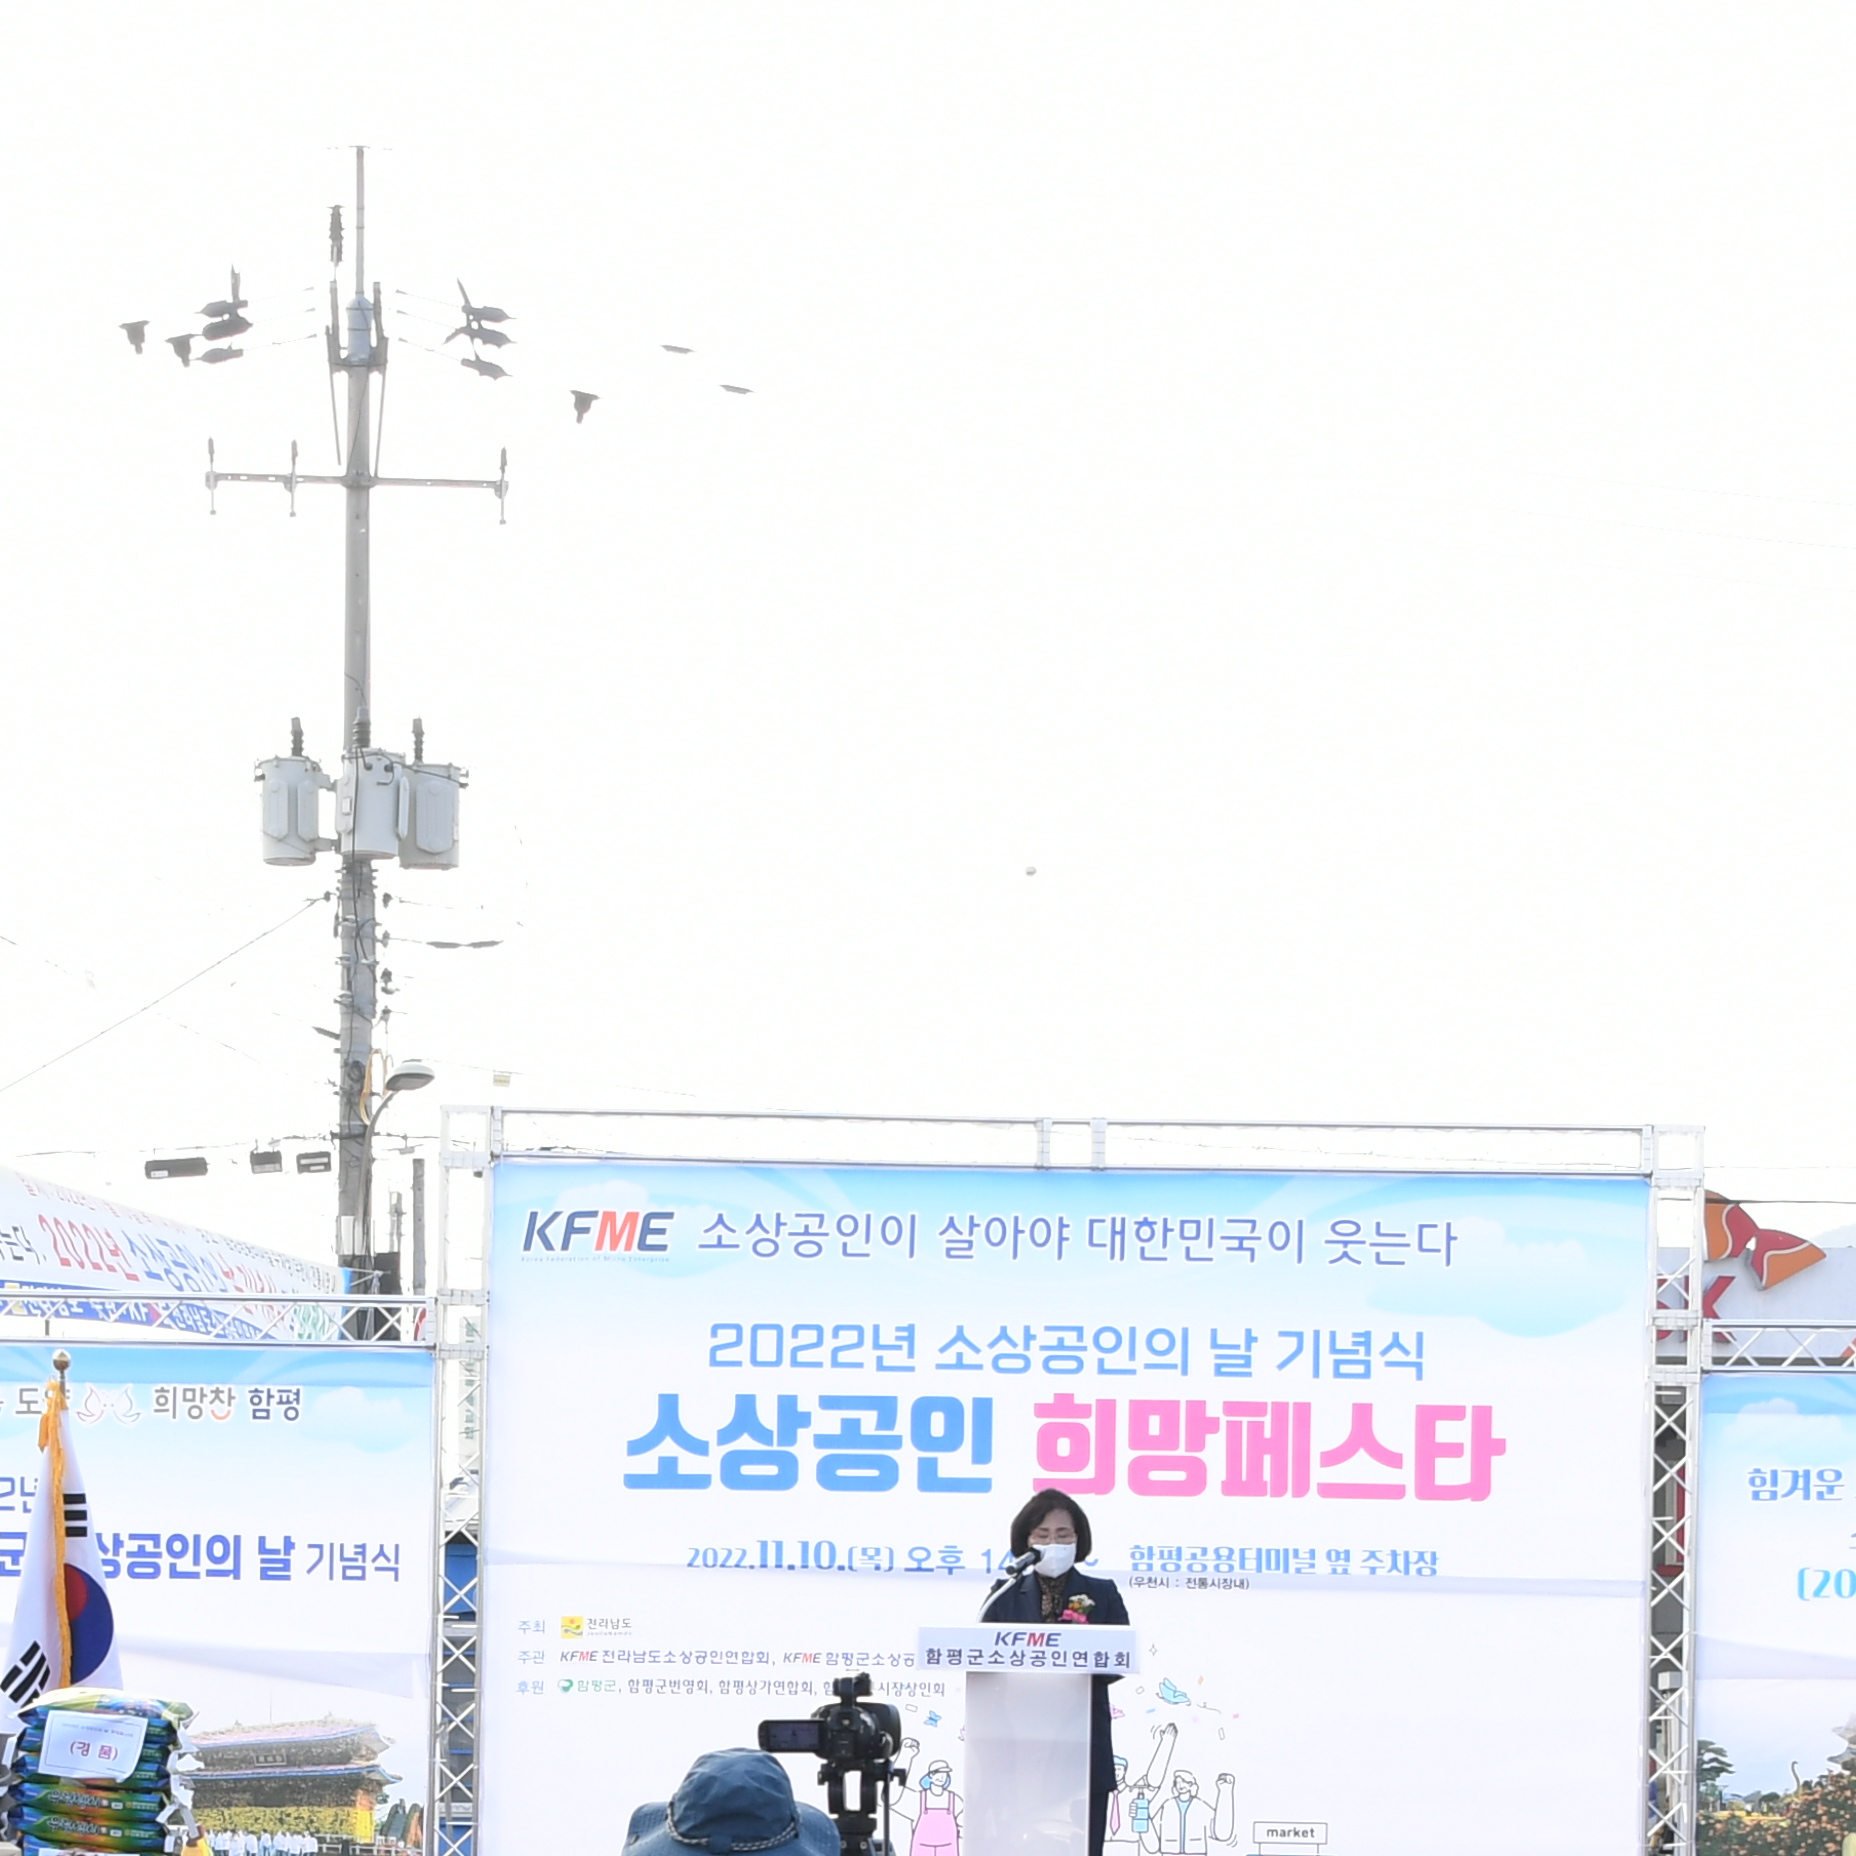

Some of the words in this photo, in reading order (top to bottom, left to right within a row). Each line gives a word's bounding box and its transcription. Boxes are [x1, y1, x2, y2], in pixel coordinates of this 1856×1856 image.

[523, 1210, 675, 1252] KFME
[698, 1212, 917, 1260] 소상공인이
[938, 1213, 1071, 1261] 살아야
[1088, 1216, 1305, 1265] 대한민국이
[1324, 1219, 1459, 1267] 웃는다
[709, 1322, 917, 1373] 2022년
[934, 1324, 1190, 1376] 소상공인의
[1209, 1328, 1259, 1378] 날
[1275, 1329, 1425, 1381] 기념식
[153, 1385, 236, 1420] 희망찬
[248, 1387, 302, 1422] 함평
[623, 1393, 994, 1495] 소상공인
[1032, 1392, 1507, 1503] 희망페스타
[1746, 1467, 1846, 1503] 힘겨운
[257, 1534, 296, 1581] 날
[305, 1542, 401, 1582] 기념식
[903, 1545, 966, 1576] 오후
[1128, 1544, 1317, 1575] 함평공용터미널
[1325, 1548, 1352, 1576] 옆
[1359, 1549, 1440, 1578] 주차장
[518, 1619, 545, 1635] 주최
[587, 1617, 633, 1631] 전라남도
[994, 1631, 1062, 1648] KFME
[517, 1650, 545, 1666] 주관
[560, 1650, 599, 1663] KFME
[783, 1652, 822, 1664] KFME
[925, 1647, 1131, 1670] 함평군소상공인연합회
[516, 1679, 545, 1696] 후원
[1266, 1827, 1316, 1839] market
